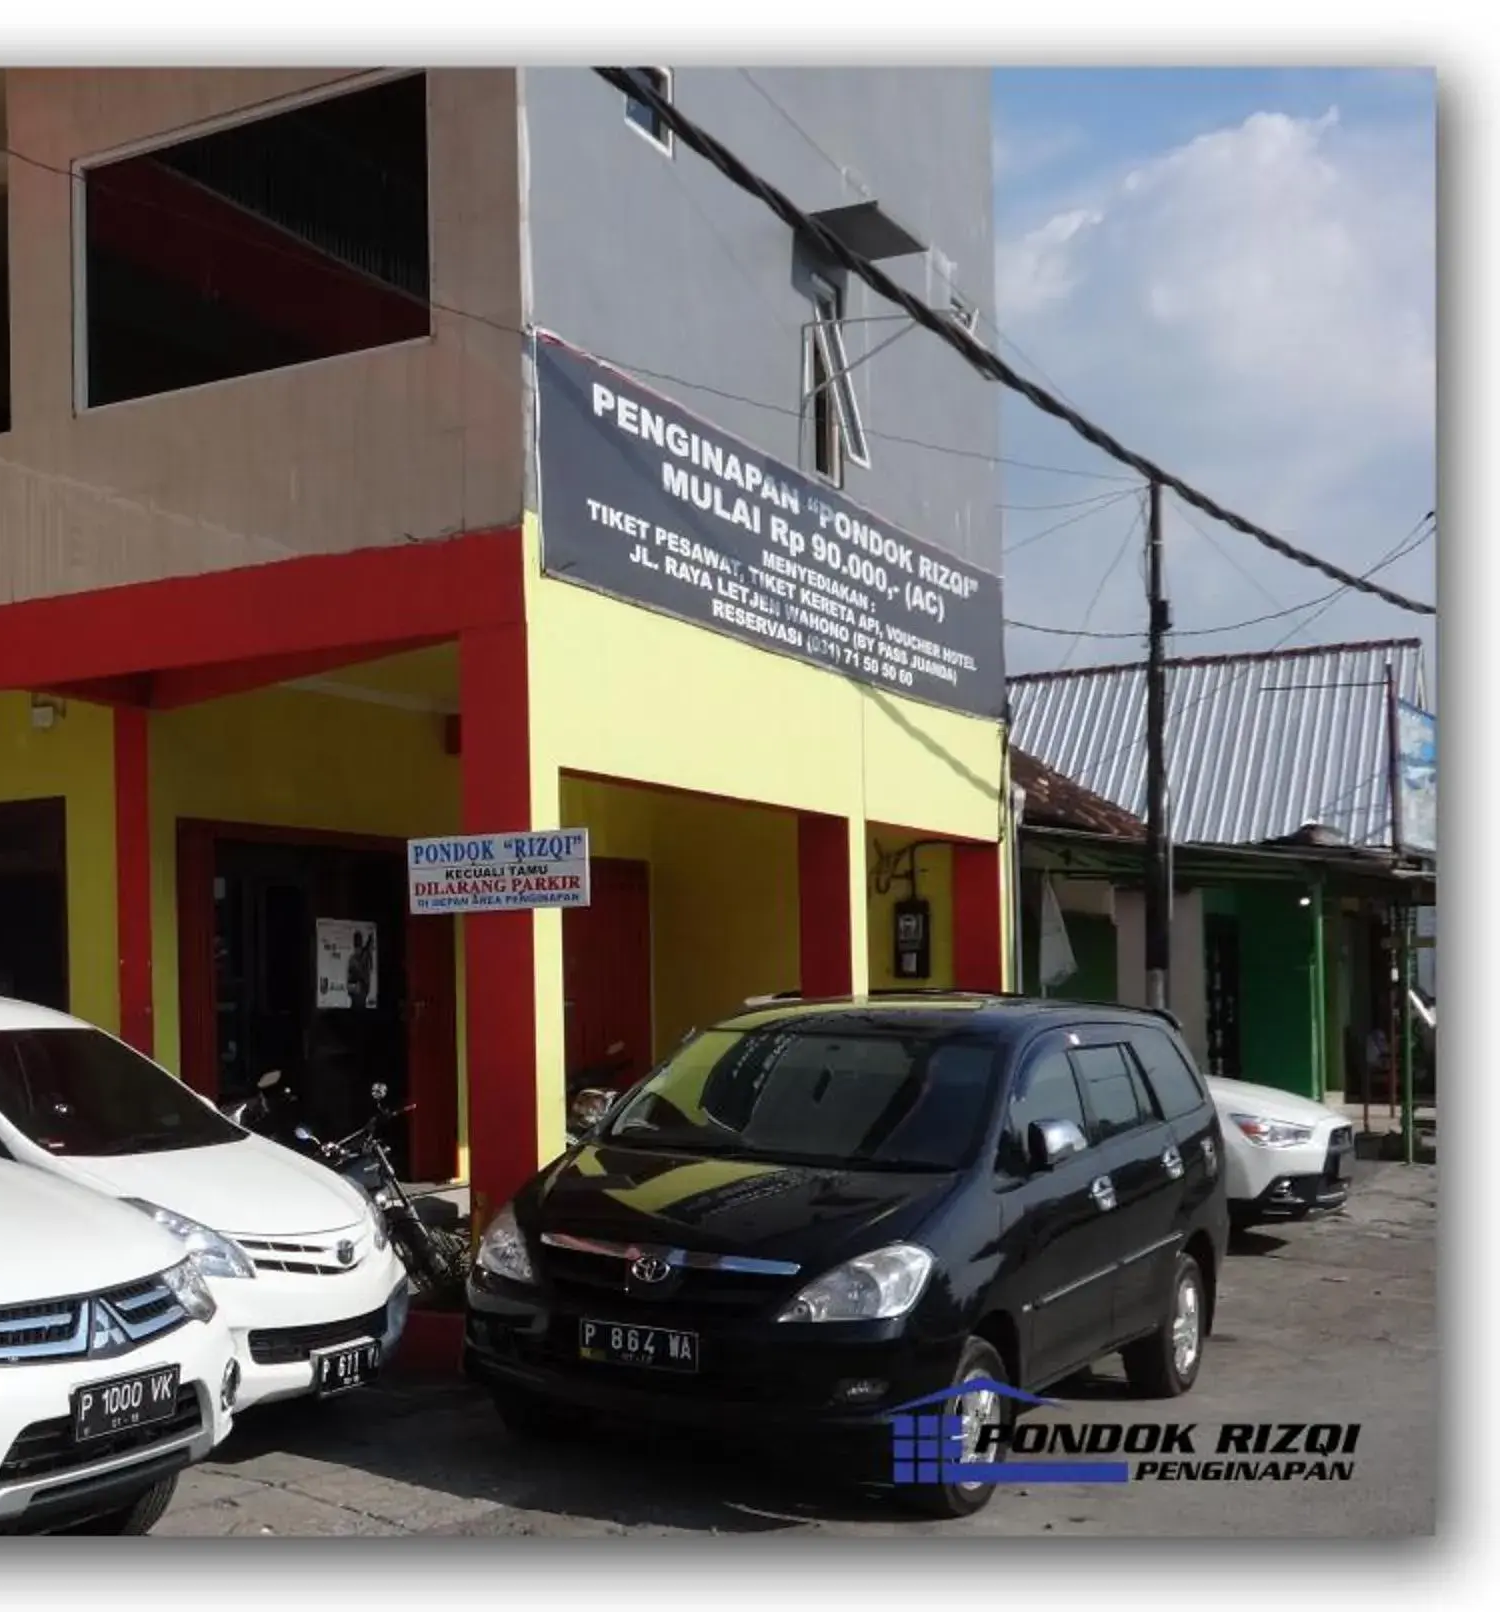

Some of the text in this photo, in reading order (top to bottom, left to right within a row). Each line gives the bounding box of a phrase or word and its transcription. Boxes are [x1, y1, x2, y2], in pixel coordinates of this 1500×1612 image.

[592, 383, 800, 515] PENGINAPAN
[662, 462, 761, 534] MULAI
[770, 515, 805, 556] Rp
[905, 581, 946, 623] (AC)
[587, 498, 650, 539] TIKET
[749, 565, 797, 600] TIKET
[801, 588, 855, 624] KERETA
[886, 624, 941, 656] VOUCHER
[943, 648, 978, 671] HOTEL
[763, 550, 869, 610] MENYEDIAKAN
[630, 544, 659, 570] JL.
[665, 555, 713, 591] RAYA
[785, 604, 849, 642] WAHONO
[853, 631, 875, 652] (BY
[878, 641, 908, 665] PASS
[911, 655, 957, 686] JUANDA)
[712, 599, 803, 646] RESERVASI
[807, 634, 841, 663] (031)
[844, 650, 859, 667] 71
[863, 656, 879, 674] 50
[413, 840, 495, 864] PONDOK
[445, 865, 548, 880] KECUALI TAMU
[414, 876, 580, 897] DILARANG PARKIR
[585, 1324, 596, 1345] P
[611, 1328, 656, 1354] 864
[668, 1333, 692, 1360] WA
[82, 1394, 93, 1421] P
[102, 1381, 143, 1414] 1000
[151, 1373, 173, 1402] VK
[322, 1358, 330, 1382] P
